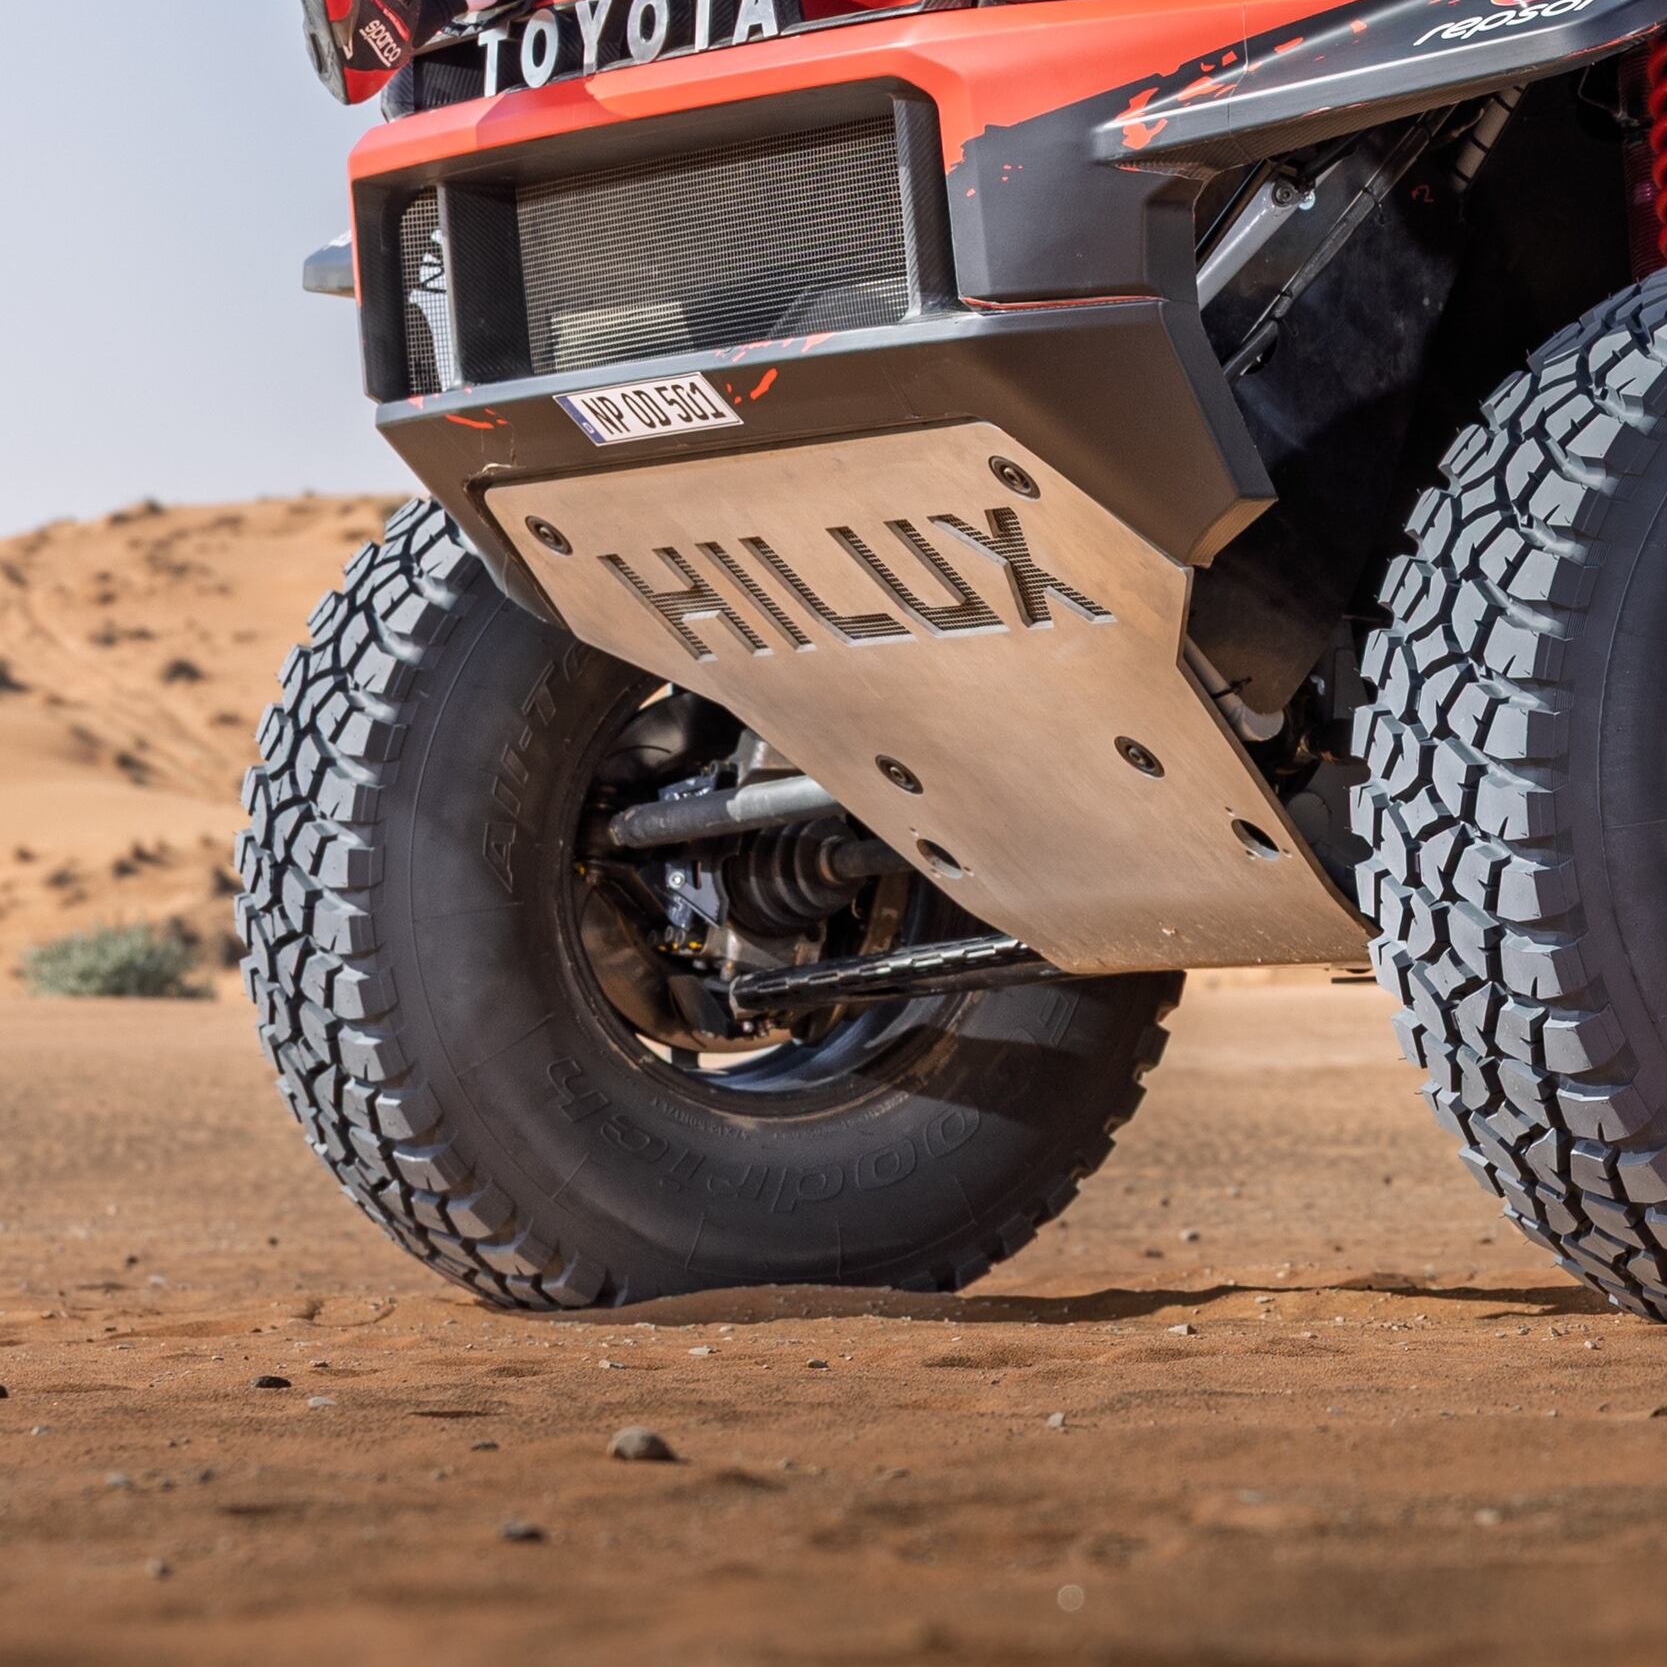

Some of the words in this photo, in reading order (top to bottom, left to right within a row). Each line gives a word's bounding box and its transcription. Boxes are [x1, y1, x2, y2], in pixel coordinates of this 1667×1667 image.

[359, 19, 402, 68] sparco
[580, 396, 631, 435] NP
[598, 507, 1115, 661] HILUX
